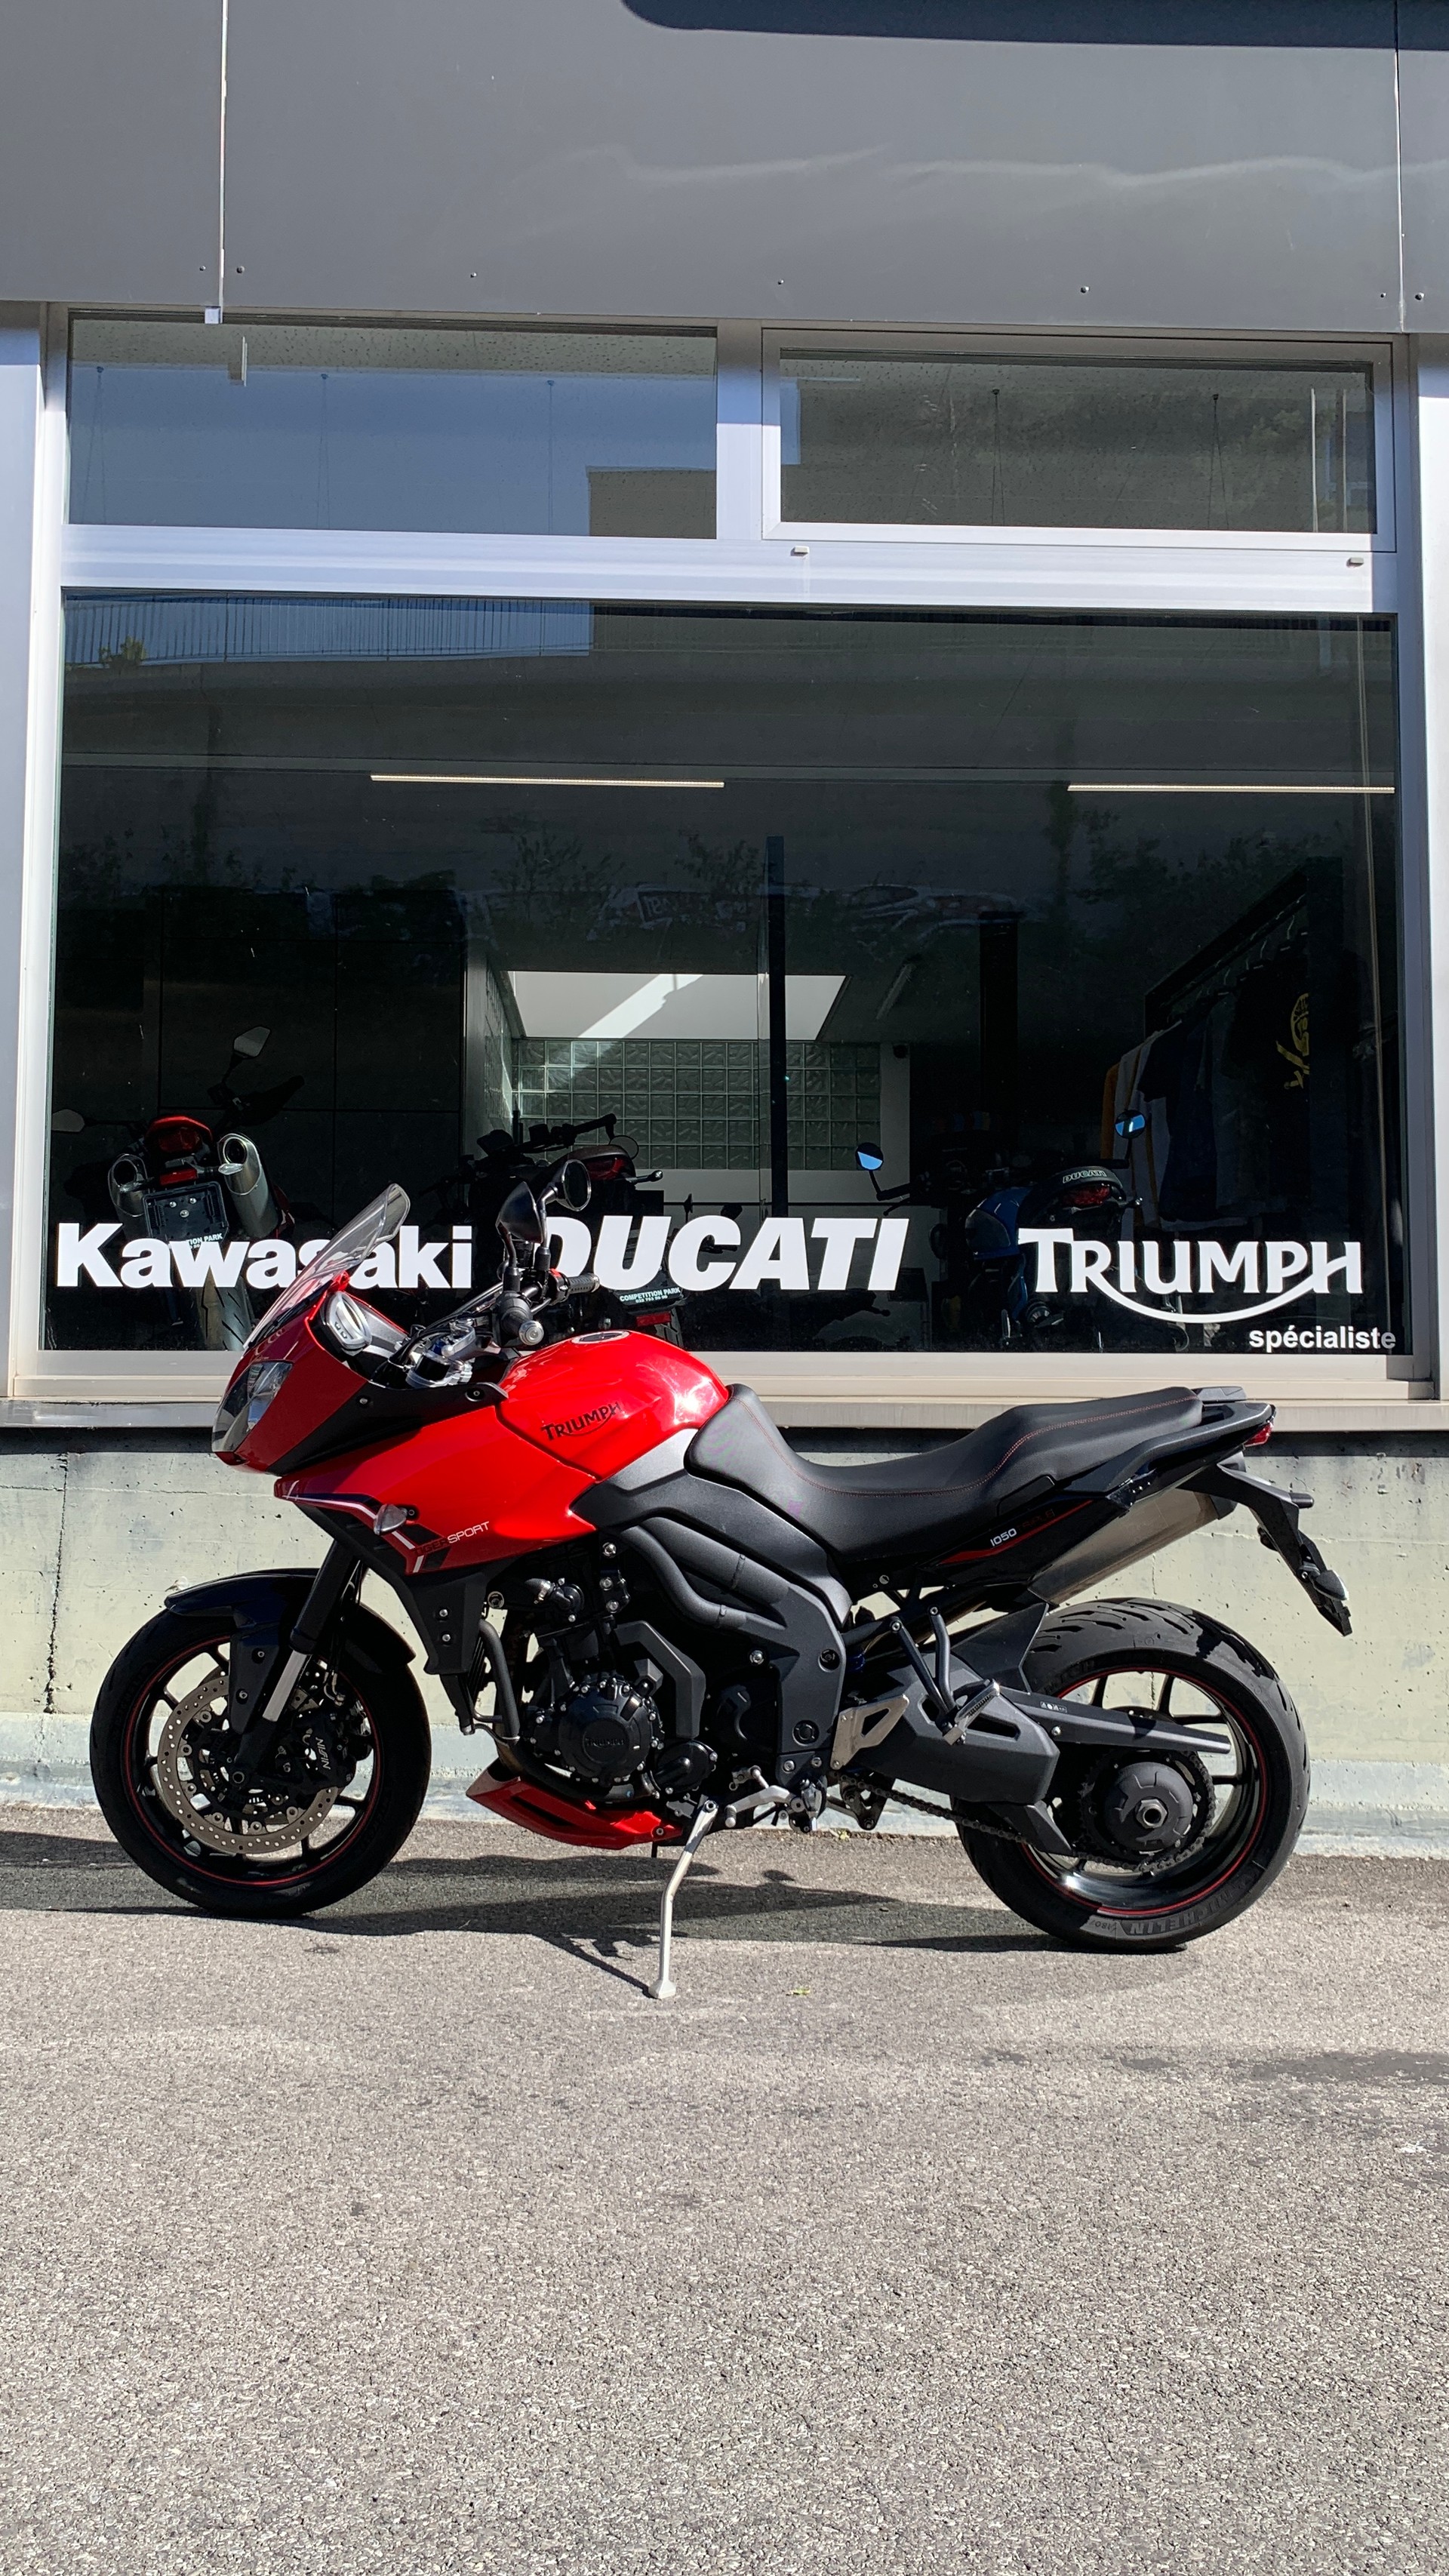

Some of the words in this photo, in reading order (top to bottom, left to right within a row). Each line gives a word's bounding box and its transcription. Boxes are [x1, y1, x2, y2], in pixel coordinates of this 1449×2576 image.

[1063, 1170, 1107, 1183] DUCATI
[533, 1213, 909, 1291] DUCATI
[1018, 1228, 1363, 1324] TRIUMPH
[620, 1289, 663, 1302] COMPETITION
[663, 1287, 681, 1296] PARK
[1249, 1325, 1396, 1353] spécialiste
[540, 1402, 622, 1441] TRIUMPH
[448, 1521, 490, 1543] SPORT
[990, 1528, 1017, 1547] 1050
